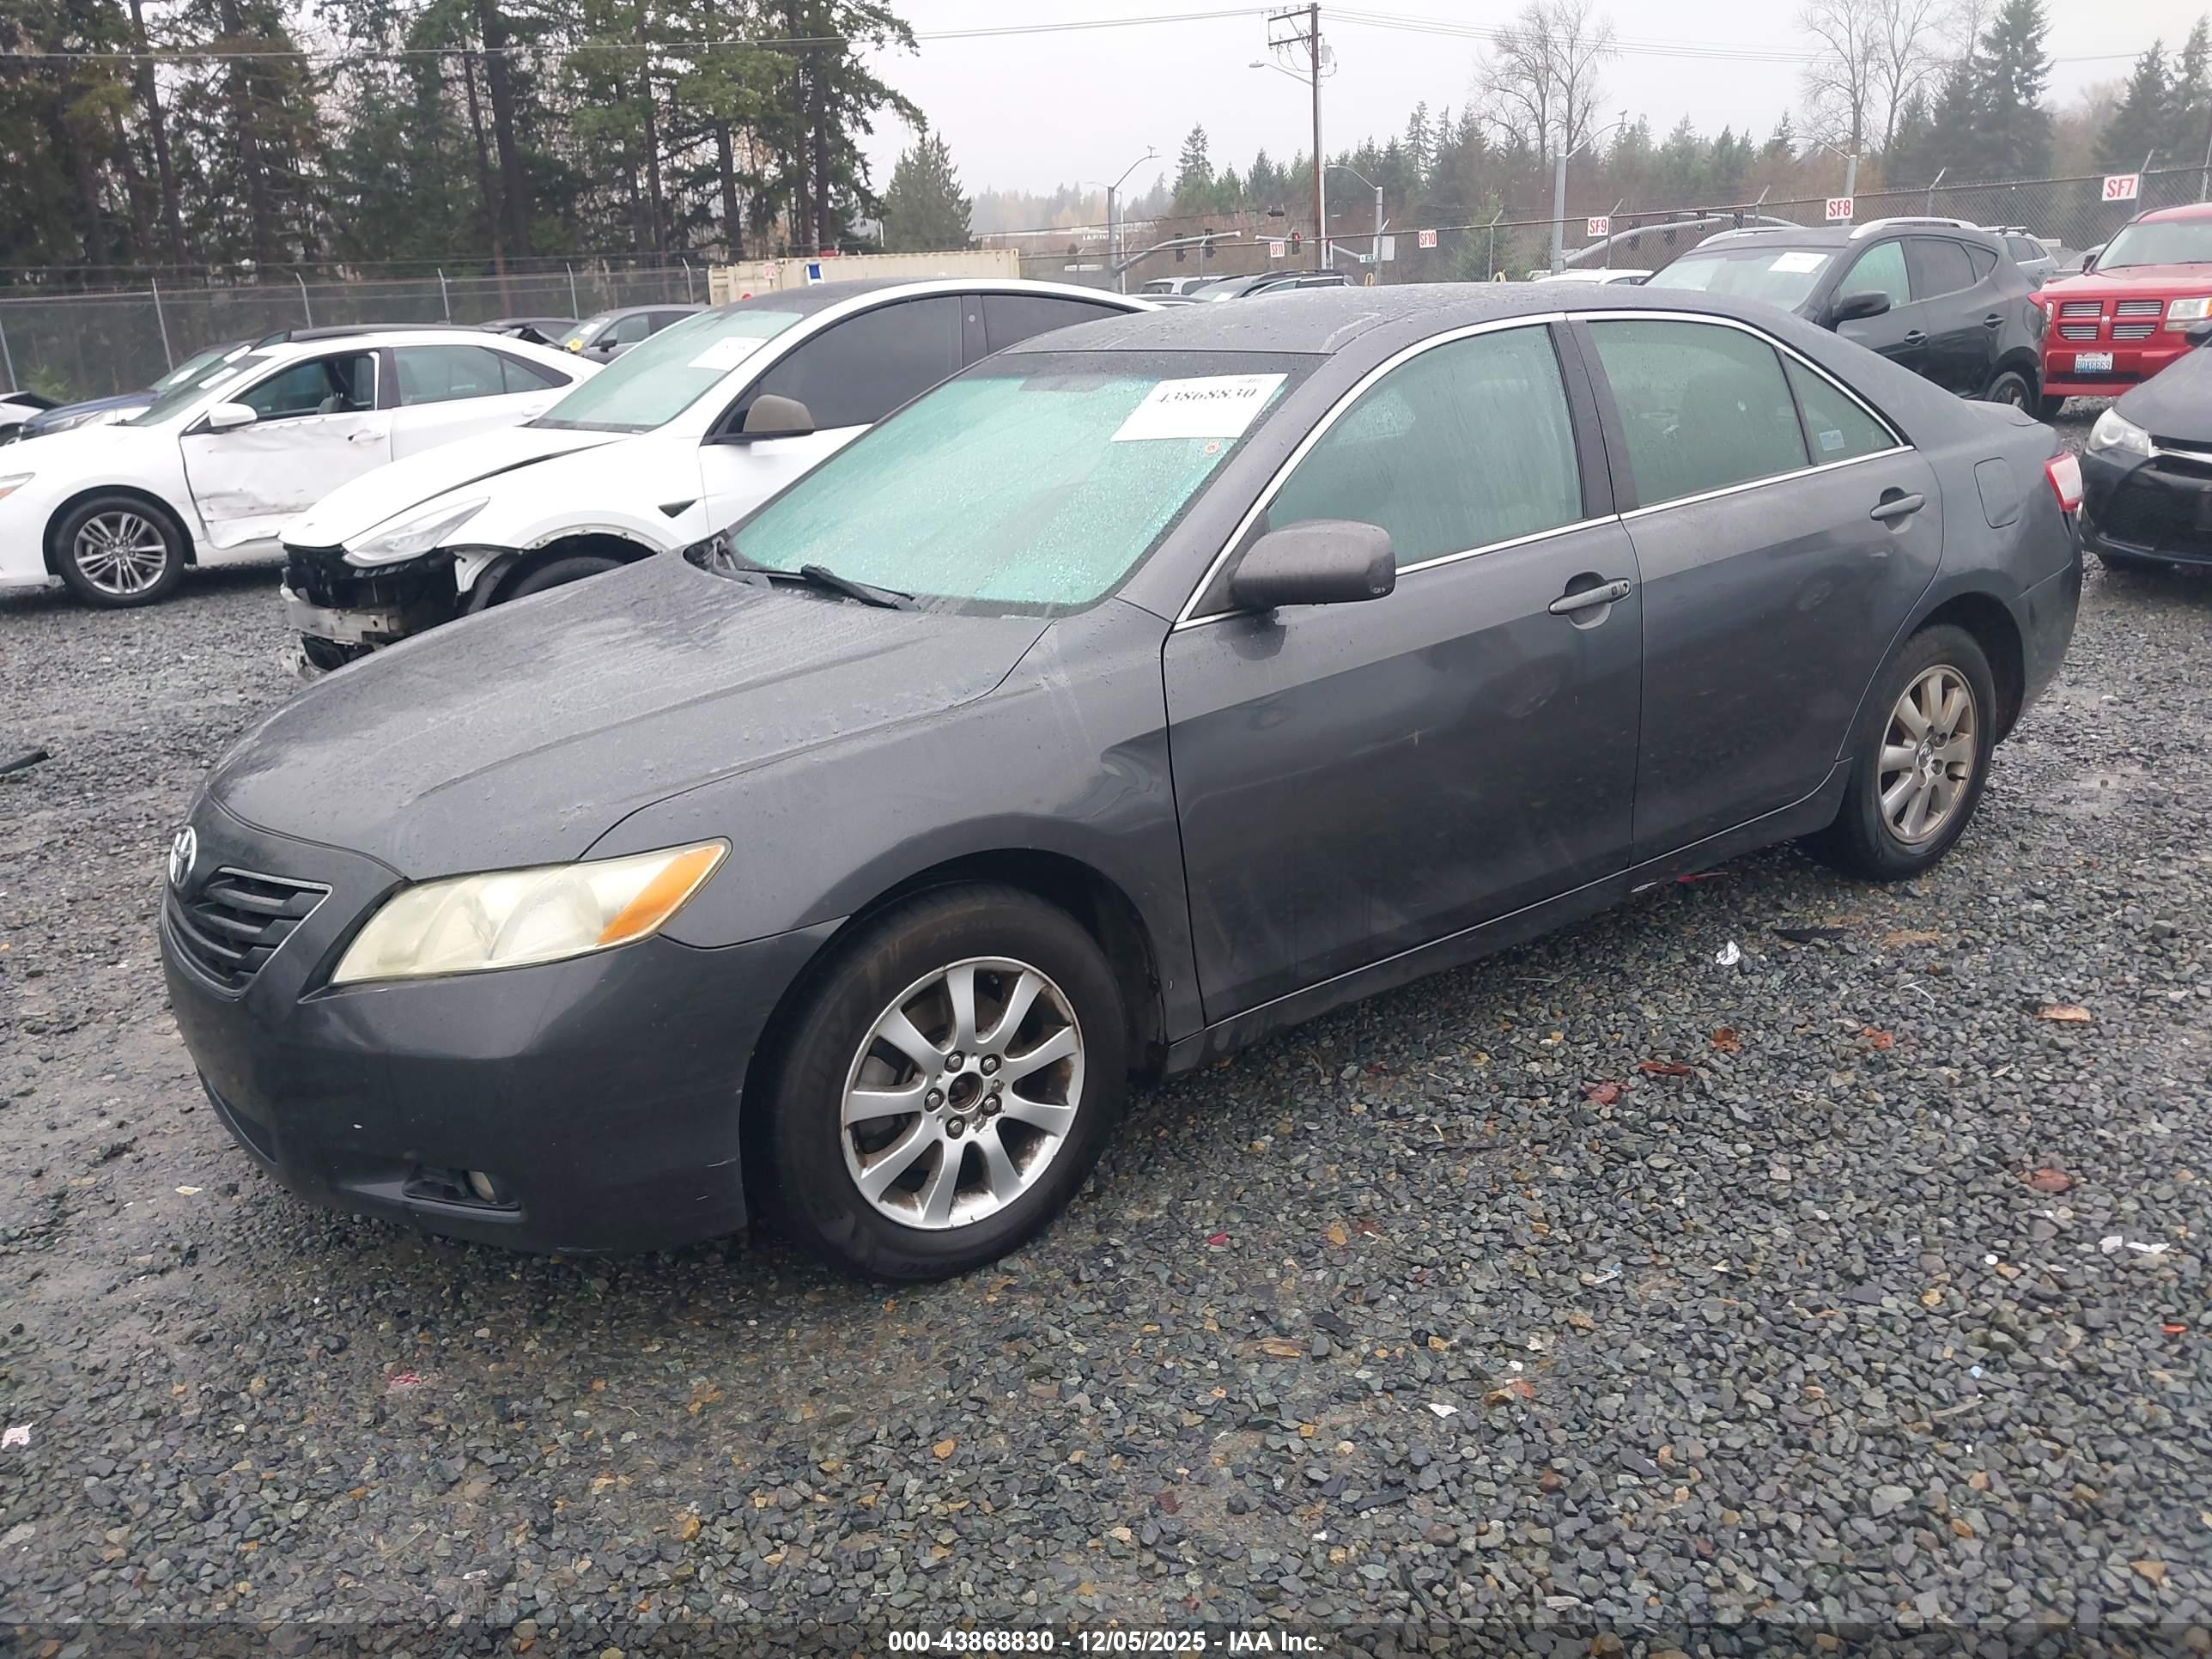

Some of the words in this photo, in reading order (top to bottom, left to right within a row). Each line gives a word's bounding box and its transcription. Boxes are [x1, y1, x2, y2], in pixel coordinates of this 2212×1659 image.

[2106, 177, 2135, 198] SF7
[1828, 199, 1851, 217] SF8
[1589, 219, 1607, 234] SF9
[1419, 233, 1436, 246] SF10
[1272, 242, 1284, 256] SF11
